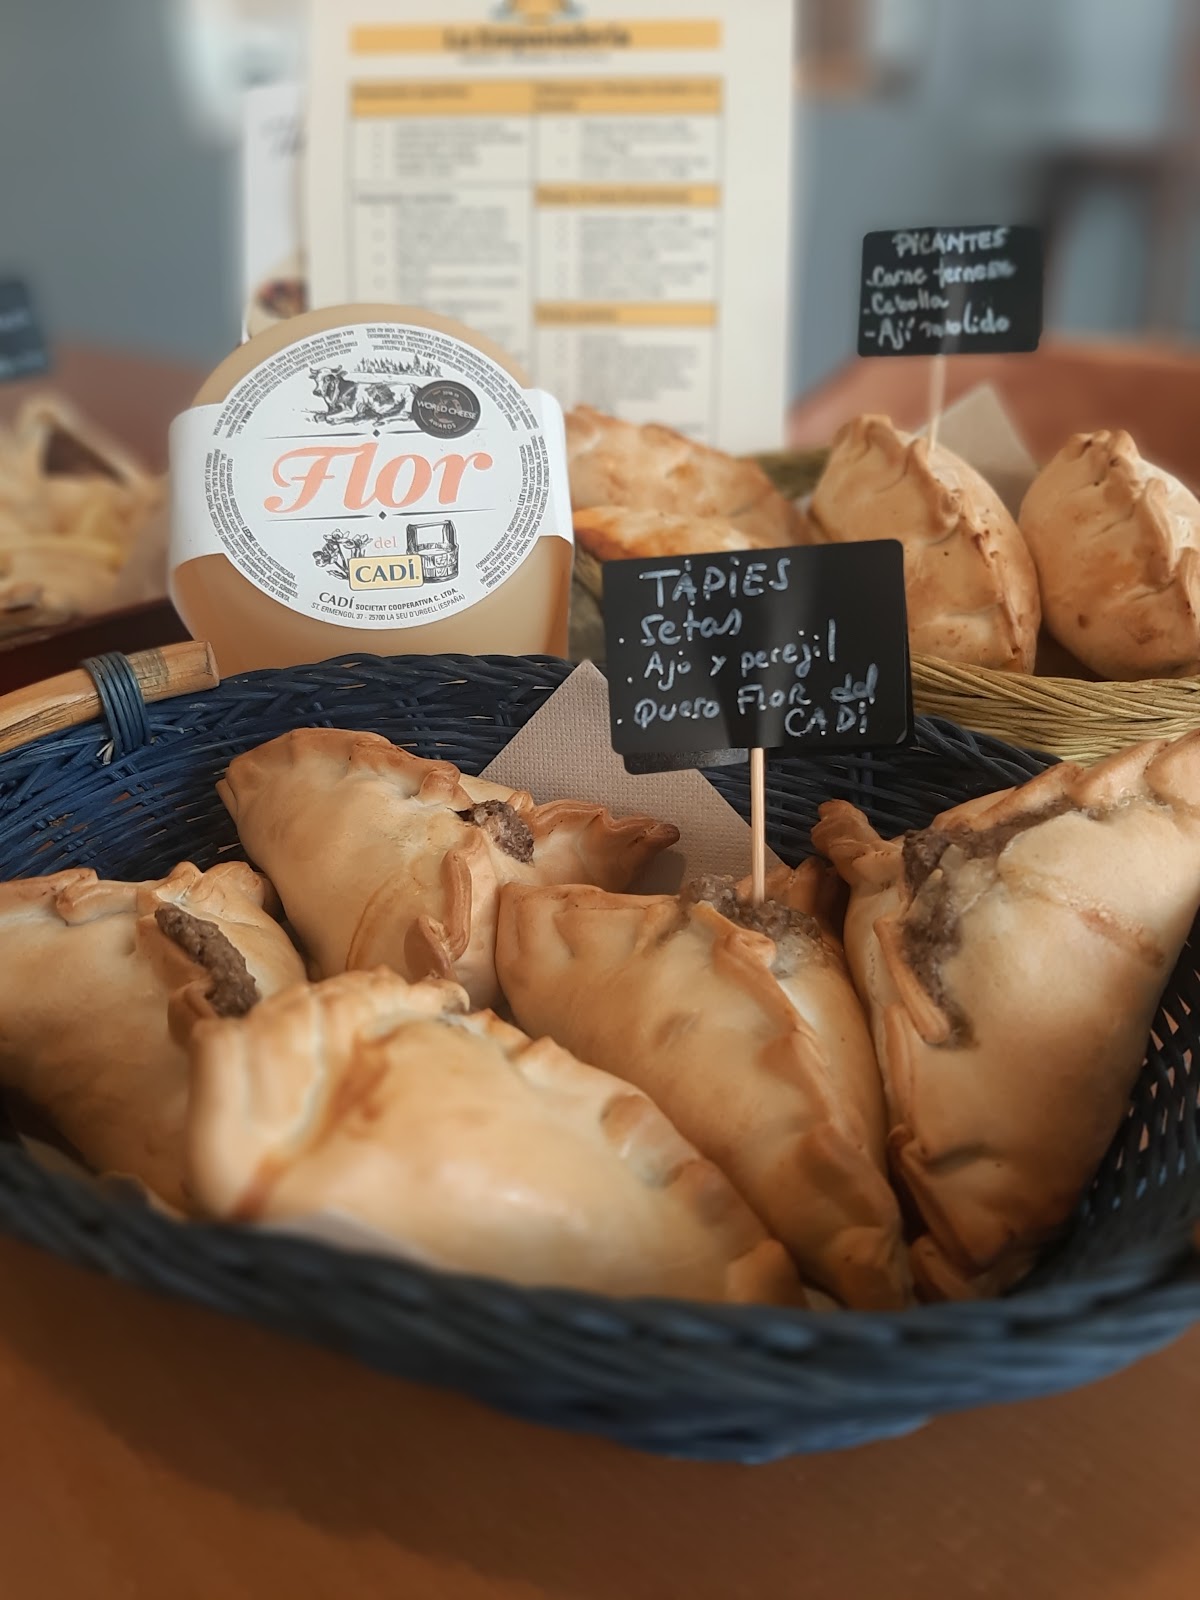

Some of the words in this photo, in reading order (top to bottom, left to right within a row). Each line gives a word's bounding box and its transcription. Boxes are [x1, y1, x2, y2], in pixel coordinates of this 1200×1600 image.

[416, 399, 448, 413] WORLD
[448, 408, 477, 420] CHEESE
[428, 418, 457, 430] AWARDS
[264, 441, 493, 513] Flor
[374, 536, 397, 549] del
[319, 592, 355, 609] CADÍ
[355, 603, 387, 612] SOCIETAT
[388, 597, 433, 611] COOPERATIVA
[440, 587, 459, 599] LTDA.
[320, 605, 355, 619] ERMENGOL
[396, 612, 408, 620] SEU
[437, 594, 465, 611] (ESPAÑA)
[645, 650, 691, 691] Ajo
[741, 619, 836, 678] perejil
[830, 663, 879, 704] del
